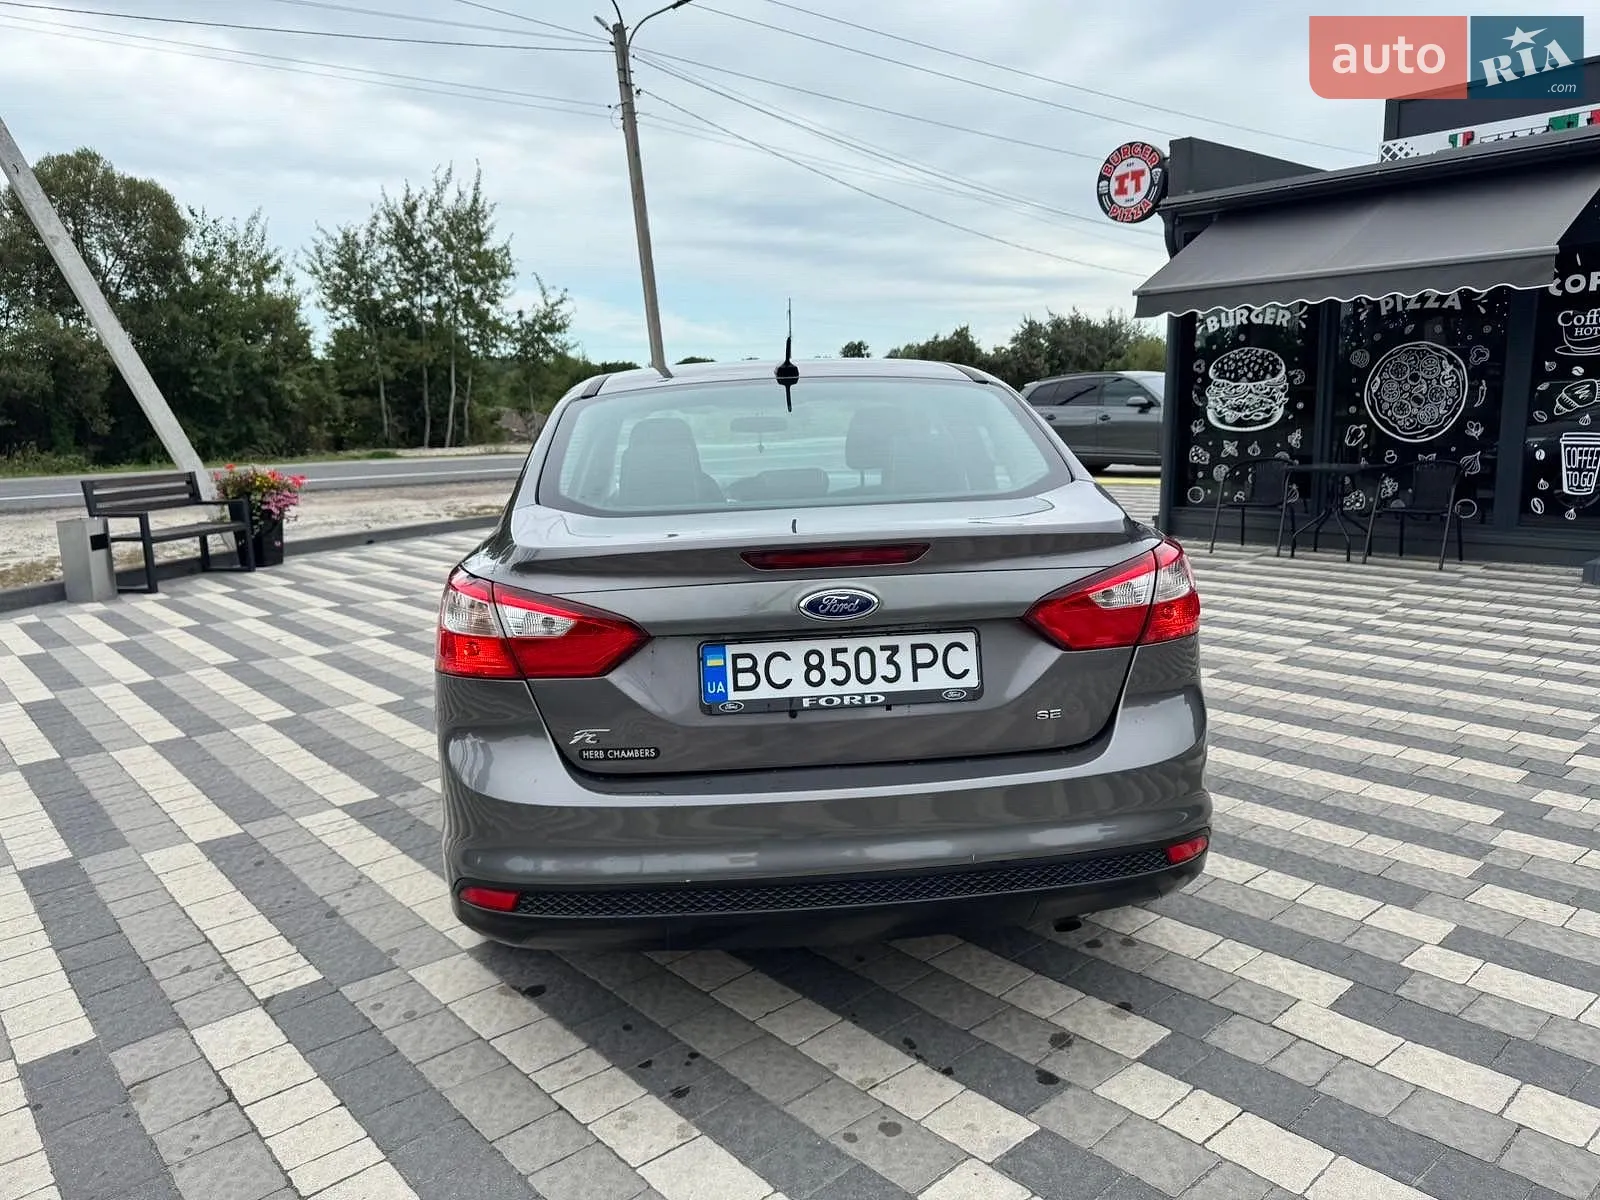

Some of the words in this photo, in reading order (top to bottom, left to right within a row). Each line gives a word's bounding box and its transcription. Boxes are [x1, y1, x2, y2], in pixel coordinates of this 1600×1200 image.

[1102, 143, 1160, 177] BURGER
[1114, 169, 1146, 196] IT
[1109, 198, 1152, 221] PIZZA
[1379, 290, 1462, 316] PIZZA
[1206, 308, 1292, 333] BURGER
[1557, 308, 1600, 327] Coff
[1574, 326, 1600, 336] HOT
[1565, 447, 1600, 469] COFFEE
[1566, 471, 1579, 486] TO
[1581, 471, 1594, 487] GO
[818, 595, 860, 614] Ford
[731, 651, 793, 692] BC
[803, 644, 902, 688] 8503
[911, 641, 970, 682] PC
[707, 682, 726, 694] UA
[802, 694, 885, 707] FORD
[1036, 709, 1062, 720] SE
[582, 750, 605, 759] HERB
[607, 748, 656, 759] CHAMBERS
